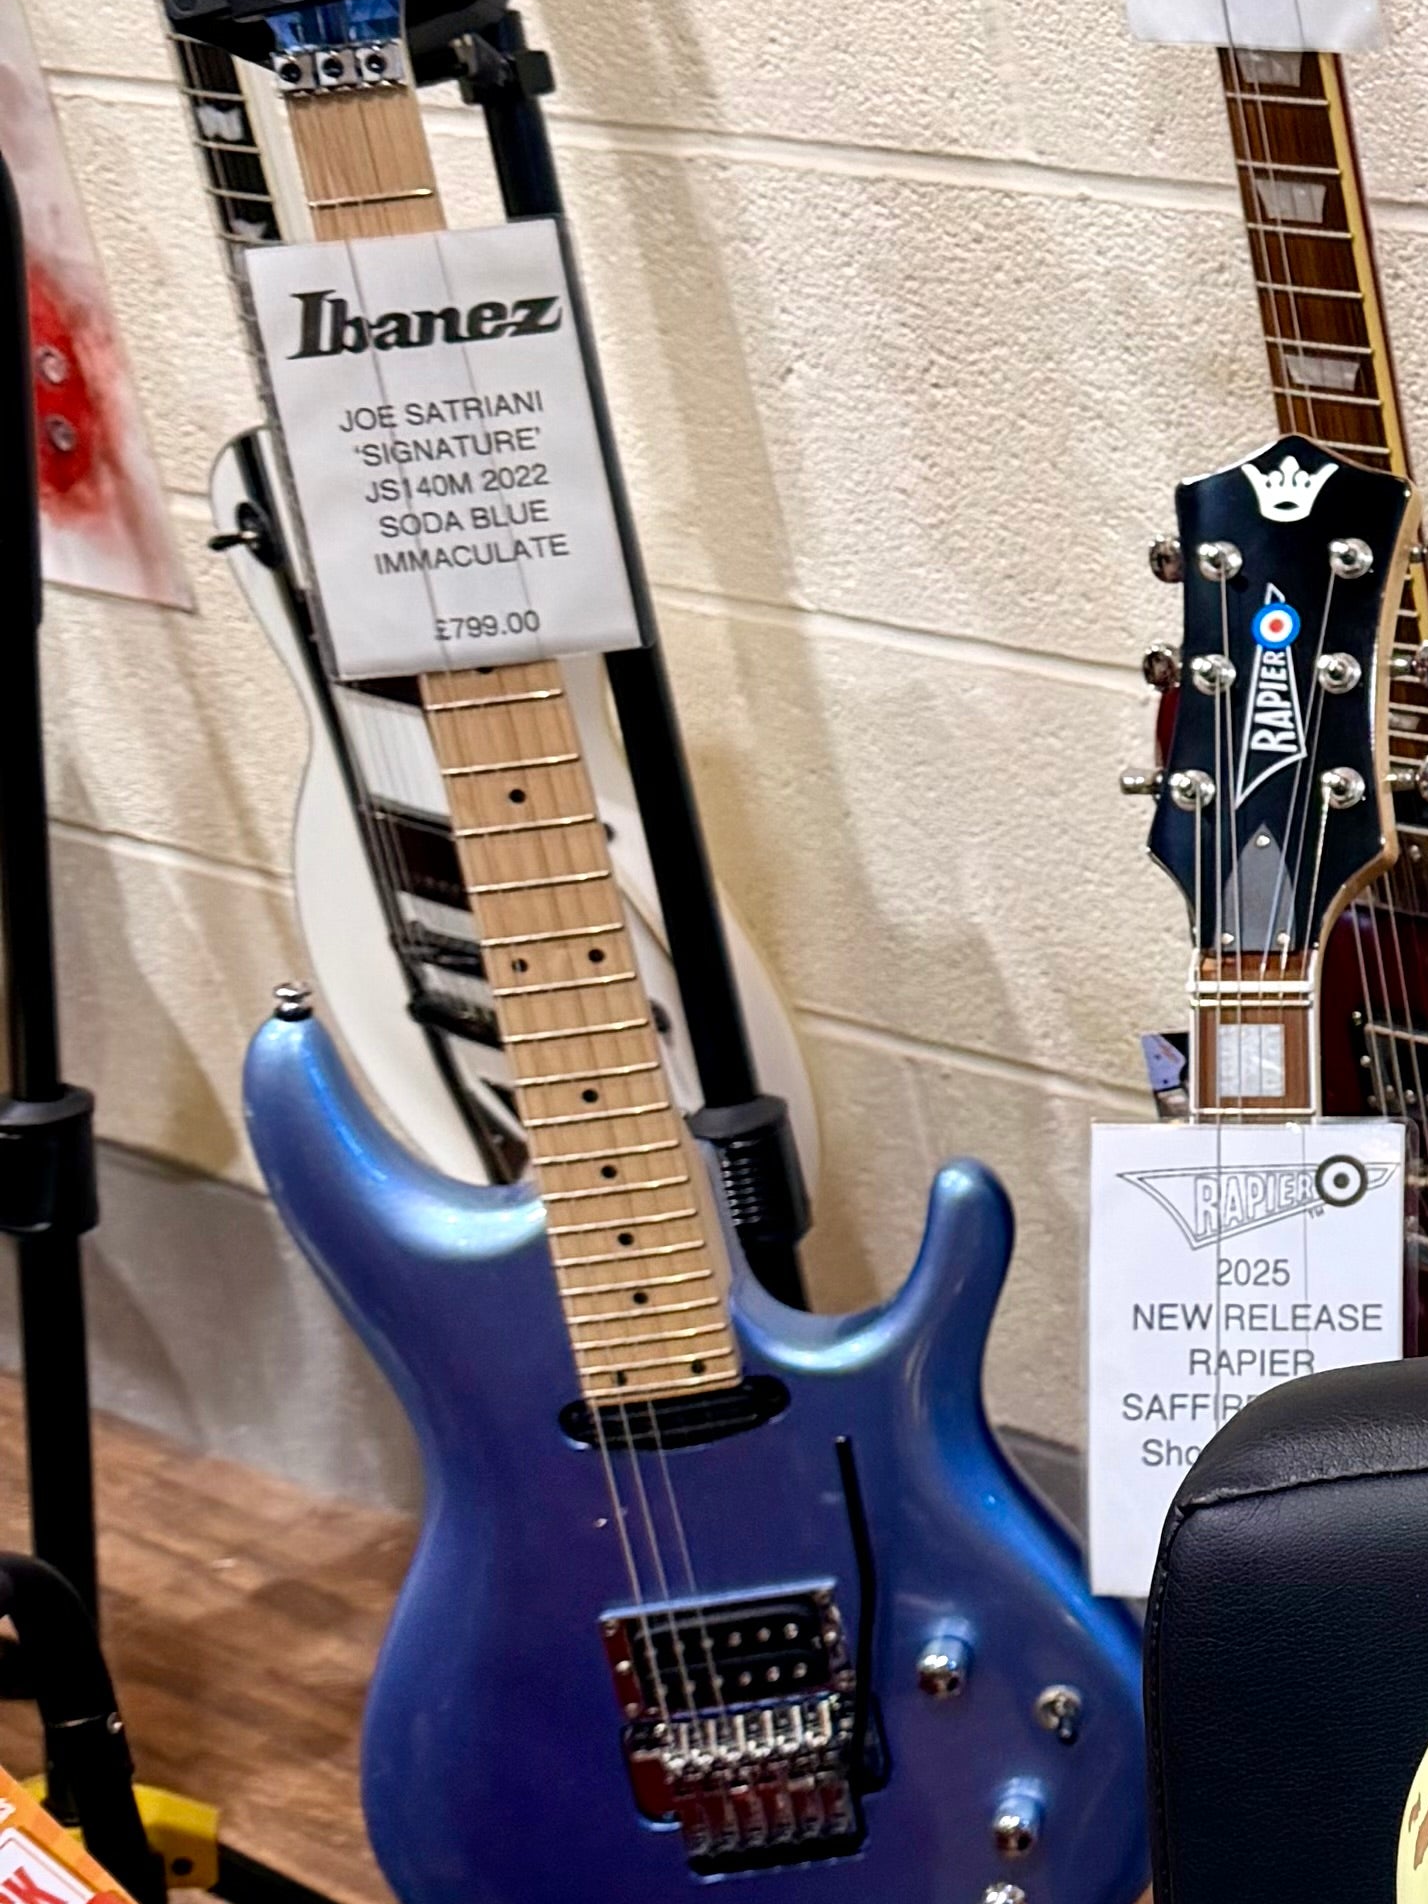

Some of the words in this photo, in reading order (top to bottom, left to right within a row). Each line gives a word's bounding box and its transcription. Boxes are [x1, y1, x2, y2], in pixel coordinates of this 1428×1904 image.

[286, 289, 563, 361] Ibanez
[339, 404, 397, 434] JOE
[404, 390, 545, 427] SATRIANI
[364, 478, 474, 504] JS140M
[481, 463, 549, 492] 2022
[379, 512, 464, 538] SODA
[471, 500, 550, 528] BLUE
[375, 533, 570, 576] IMMACULATE
[435, 609, 541, 641] £799.00
[1250, 650, 1298, 753] RAPIER
[1193, 1171, 1318, 1239] RAPIER
[1218, 1258, 1291, 1287] 2025
[1133, 1303, 1214, 1331] NEW
[1225, 1303, 1384, 1331] RELEASE
[1189, 1348, 1316, 1377] RAPIER
[1122, 1393, 1258, 1421] SAFFIR
